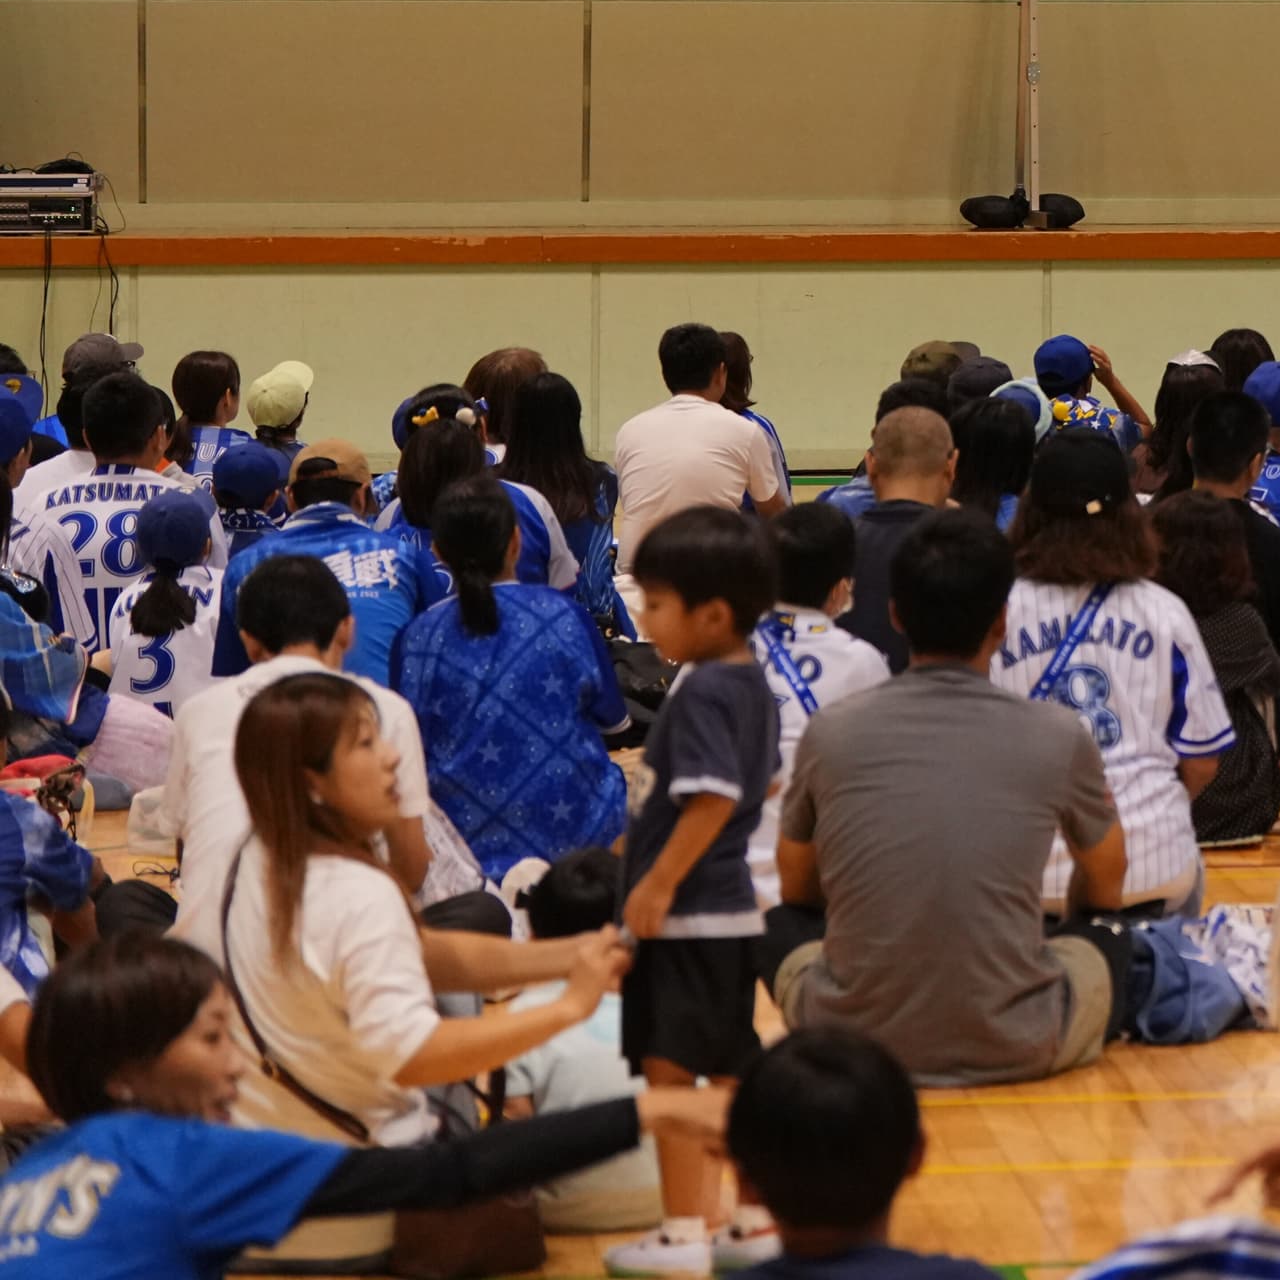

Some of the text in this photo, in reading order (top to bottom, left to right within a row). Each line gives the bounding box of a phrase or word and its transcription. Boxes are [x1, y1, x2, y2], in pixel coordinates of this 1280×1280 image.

[45, 482, 164, 509] KATSUMAT
[59, 508, 148, 578] 28
[130, 630, 176, 694] 3
[1000, 615, 1154, 669] KAMIATO
